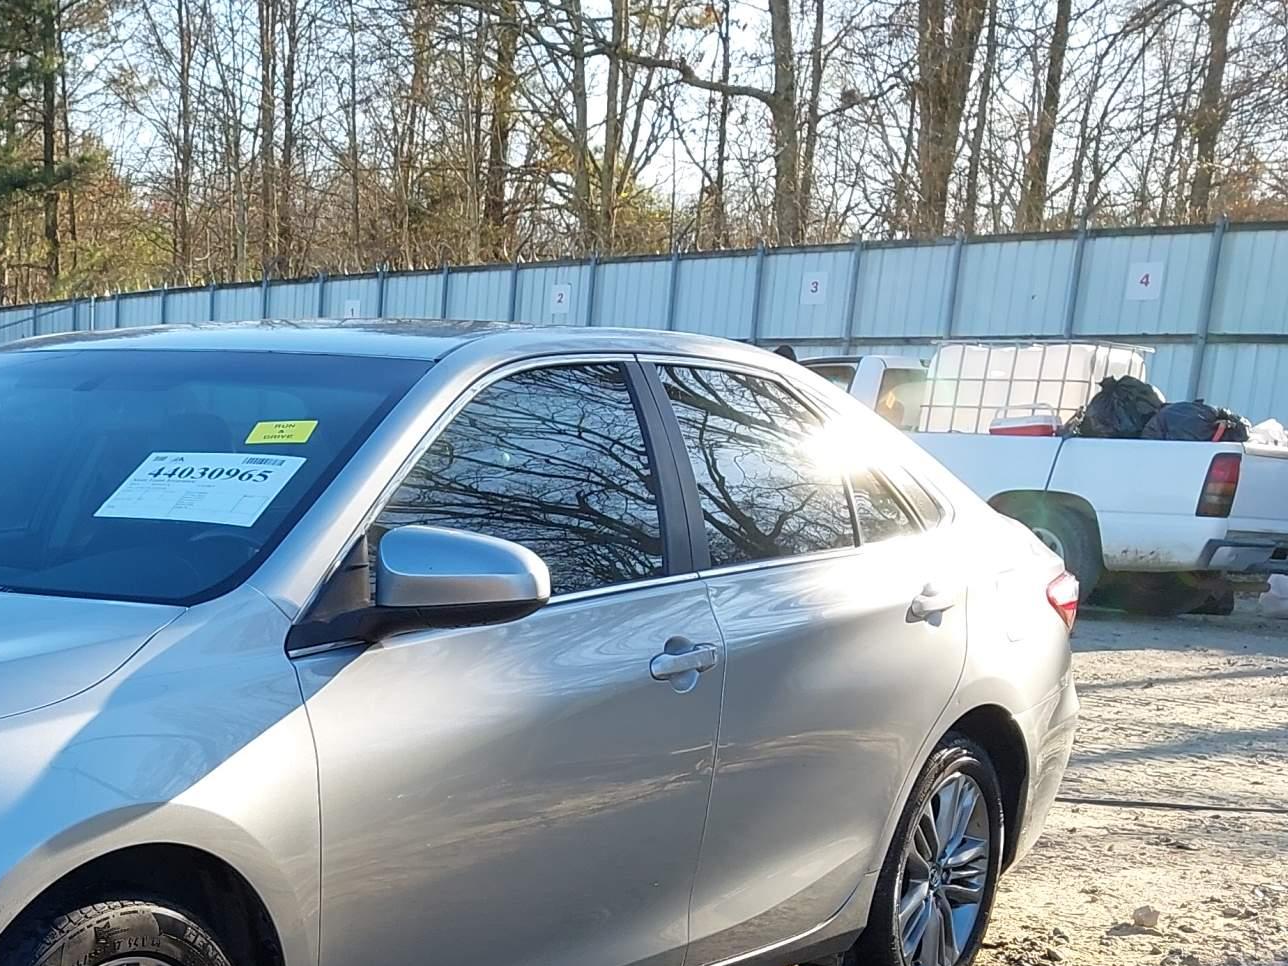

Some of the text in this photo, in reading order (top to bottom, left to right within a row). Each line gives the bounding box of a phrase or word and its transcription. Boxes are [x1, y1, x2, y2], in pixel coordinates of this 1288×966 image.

[1140, 273, 1150, 287] 4
[810, 281, 819, 293] 3
[556, 292, 564, 304] 2
[148, 466, 273, 482] 44030965
